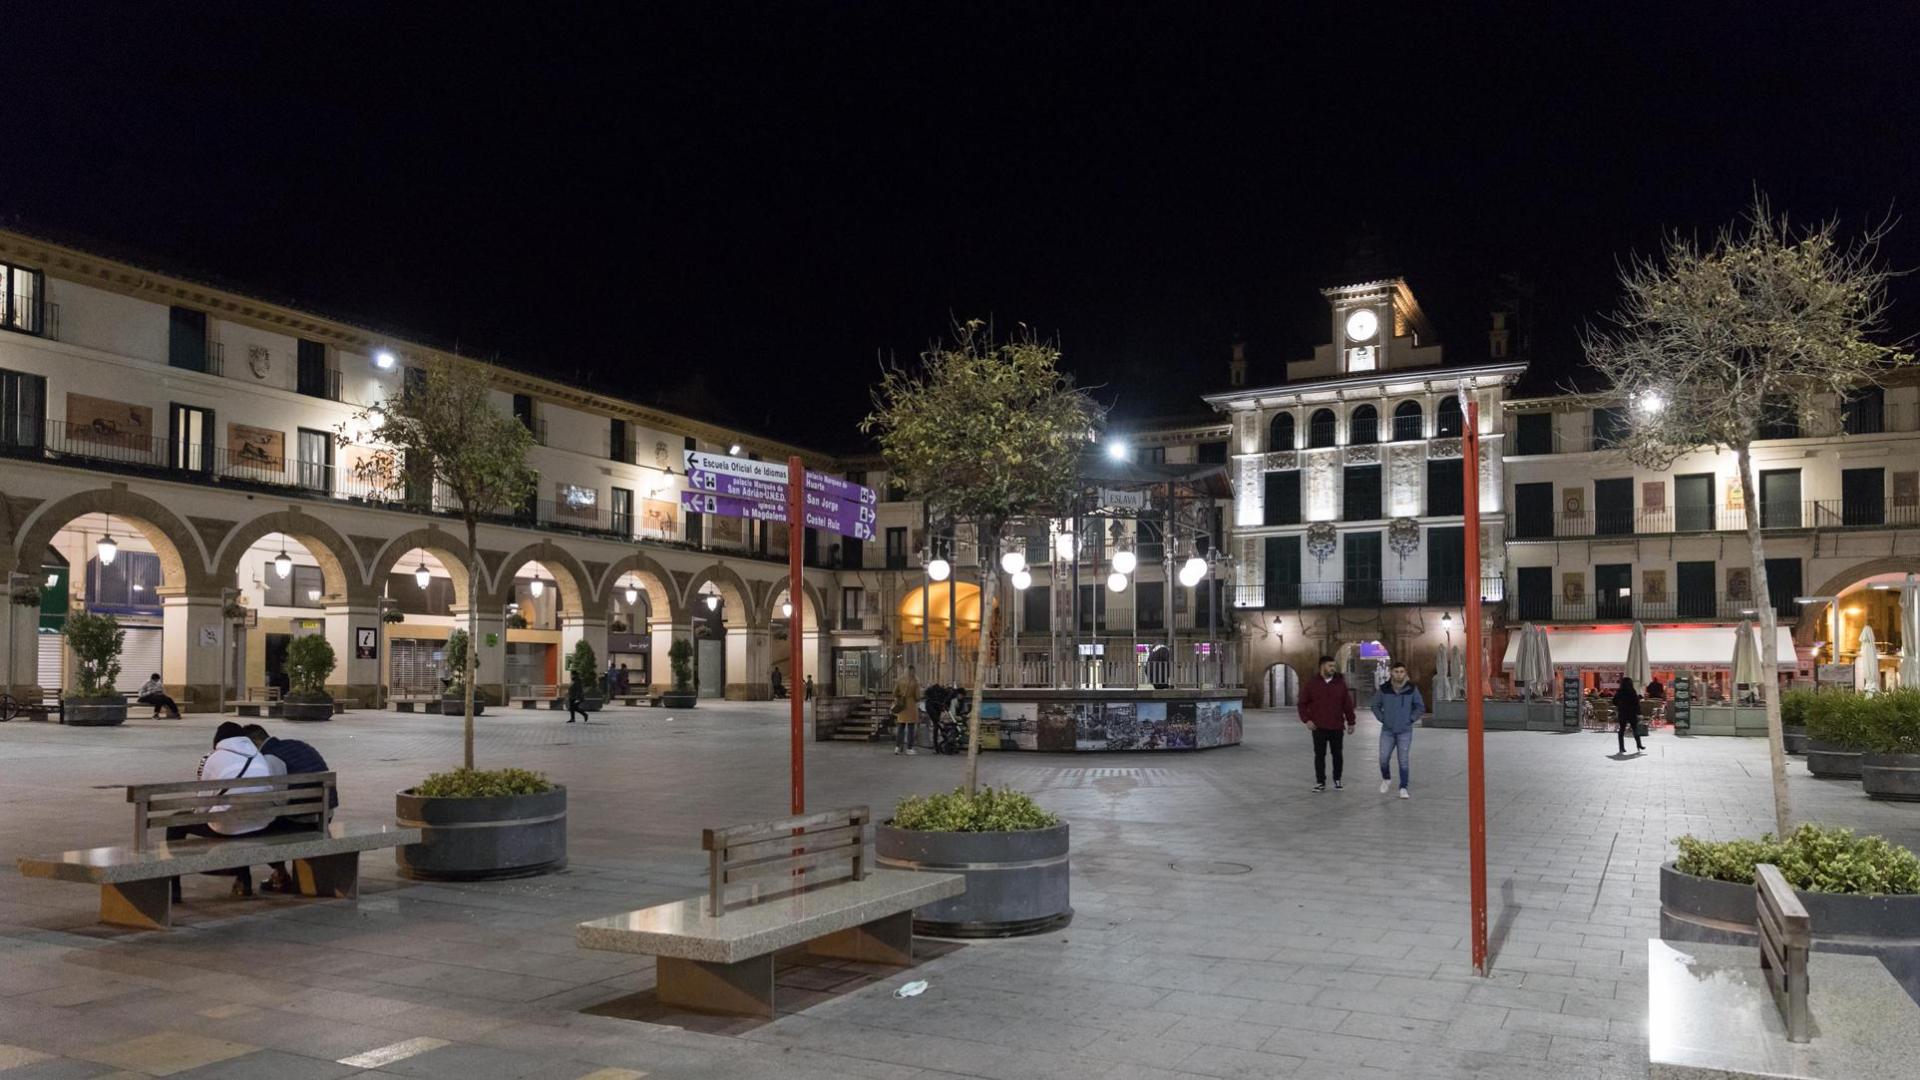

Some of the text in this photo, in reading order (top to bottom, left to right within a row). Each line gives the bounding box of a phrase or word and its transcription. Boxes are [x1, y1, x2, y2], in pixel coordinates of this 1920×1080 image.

[703, 458, 787, 479] Escuela Oficial de Idiomas
[727, 484, 740, 496] San
[806, 479, 825, 491] Huarte
[807, 493, 839, 512] San Jorge
[742, 507, 787, 522] la Magdalena
[806, 513, 840, 530] Castel Ruiz
